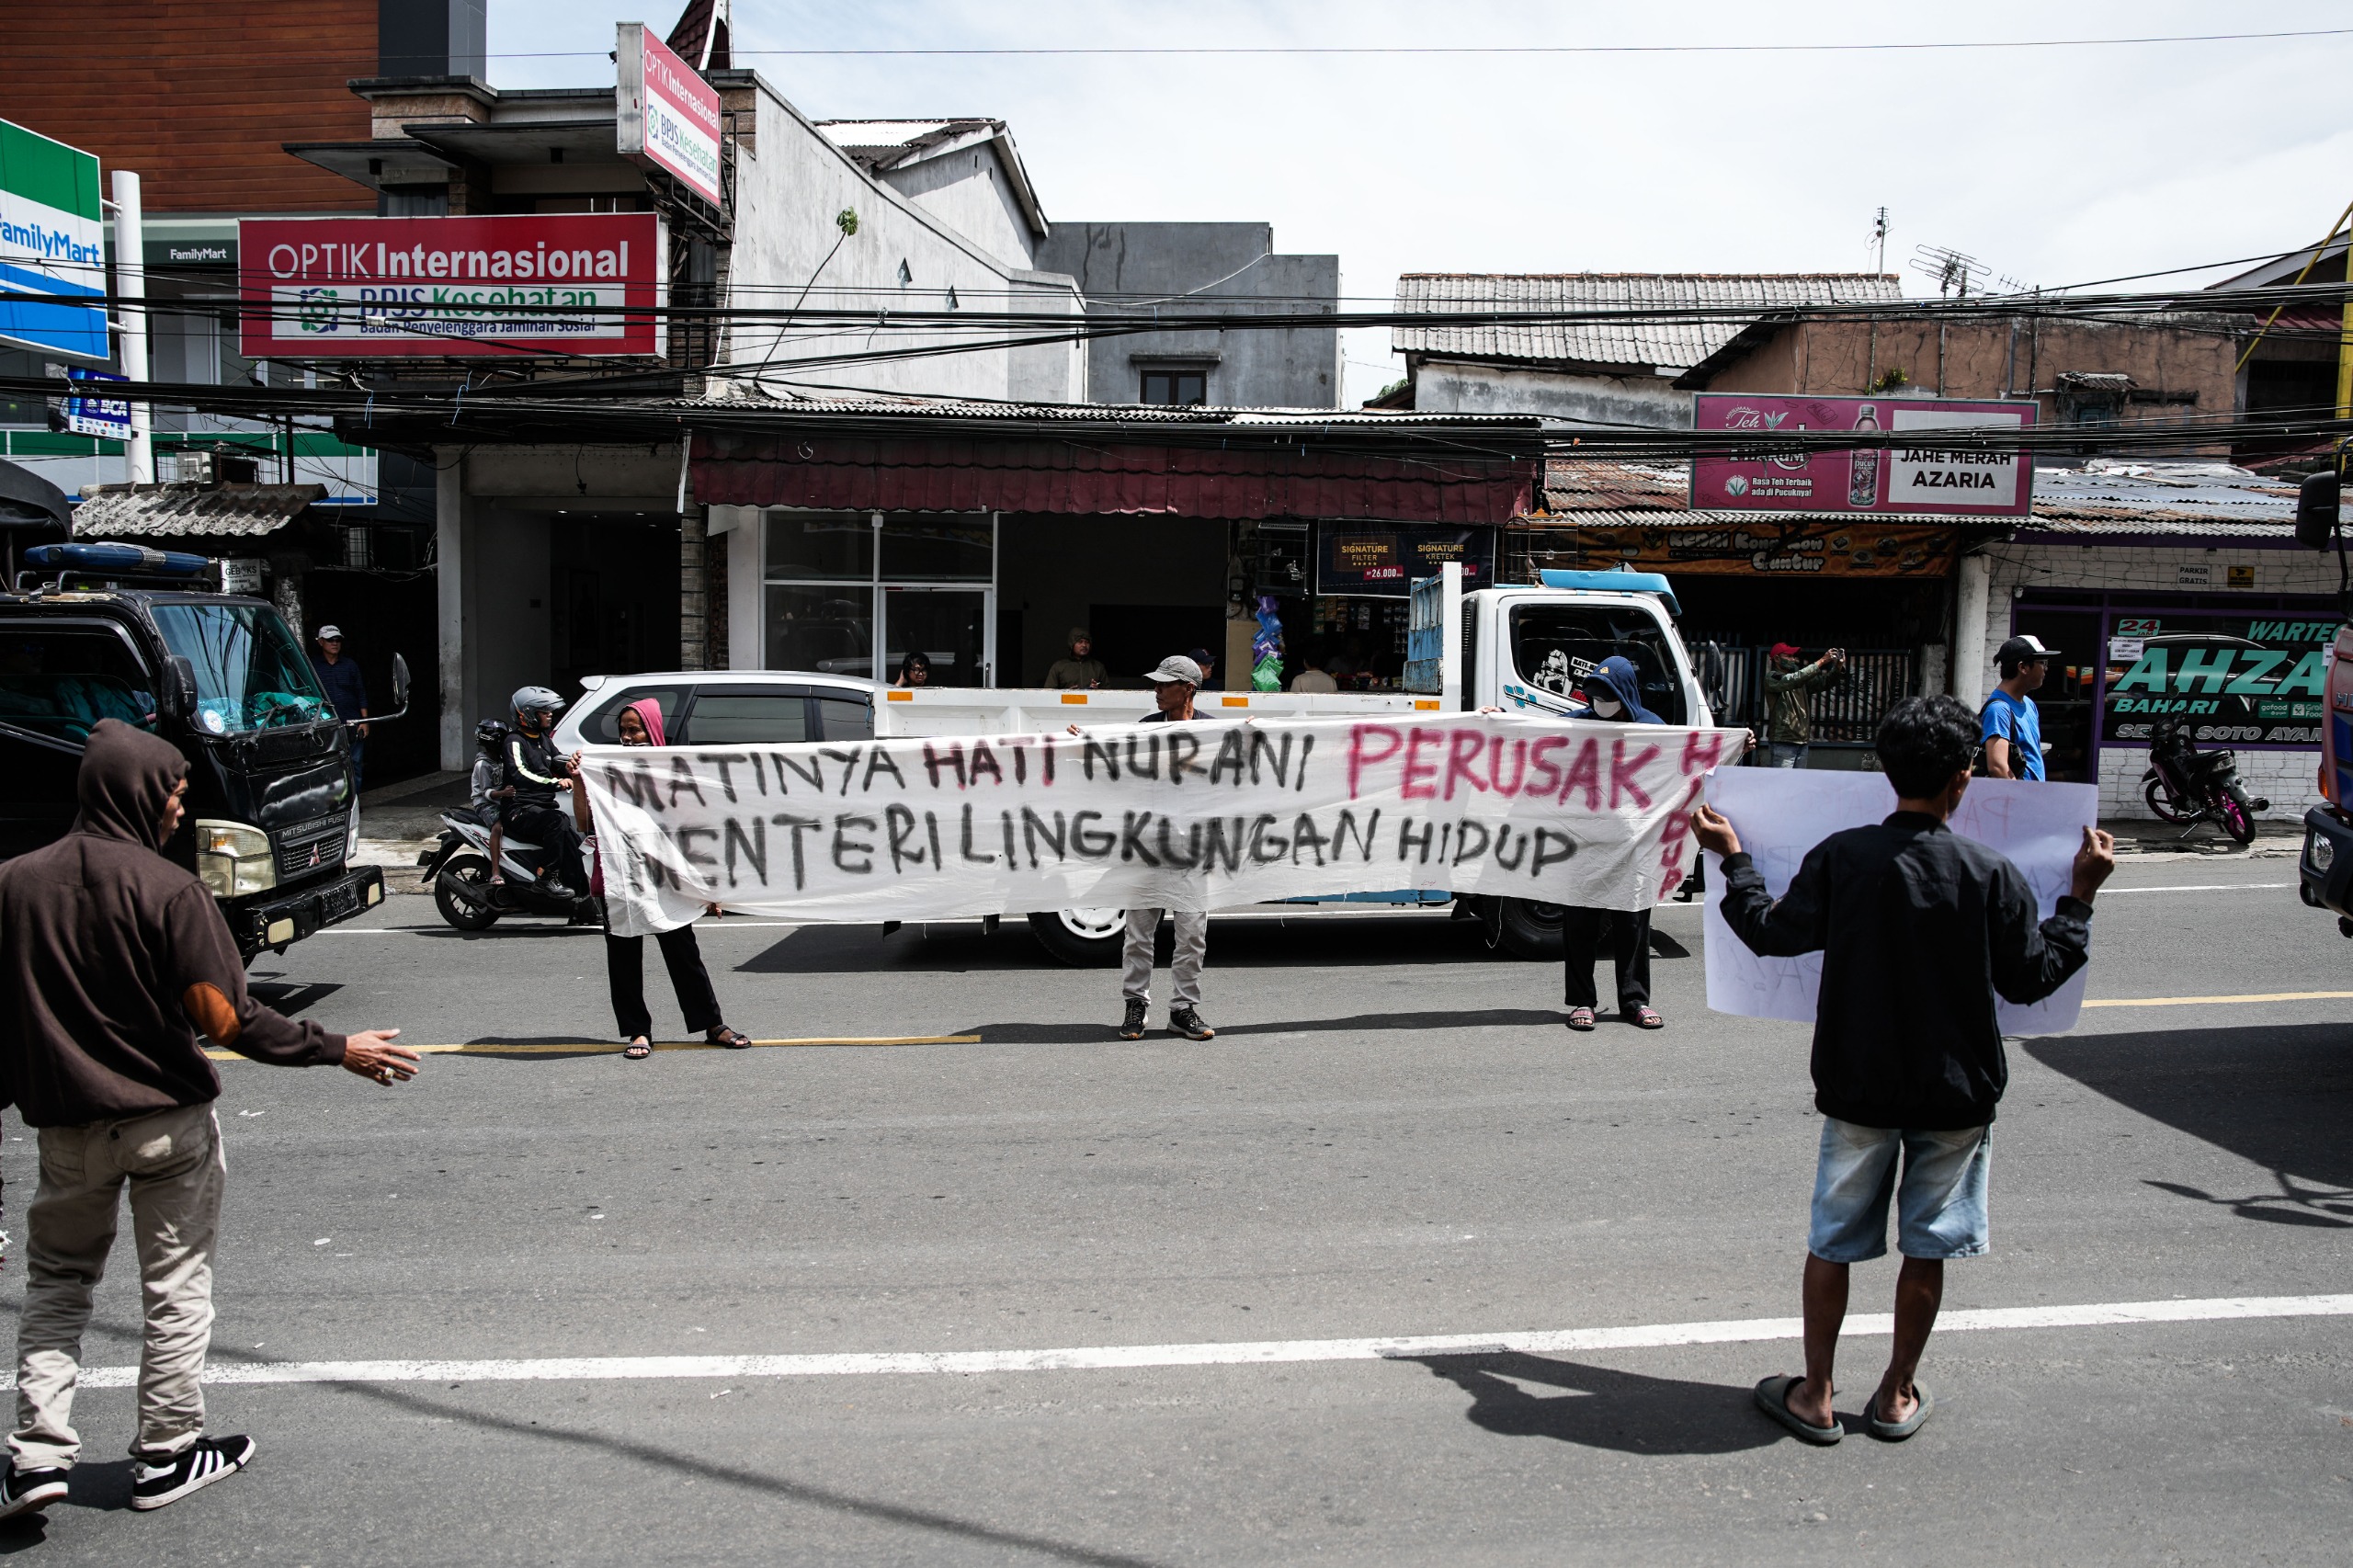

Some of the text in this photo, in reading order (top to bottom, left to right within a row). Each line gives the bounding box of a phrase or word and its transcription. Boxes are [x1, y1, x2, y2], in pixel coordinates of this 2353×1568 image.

[645, 49, 719, 131] OPTIK Internasional
[661, 114, 718, 175] BPJS Kesehatan
[0, 213, 100, 267] amilyMart
[170, 247, 227, 261] FamilyMart
[268, 241, 628, 279] OPTIK Internasional
[433, 287, 597, 318] Kesehatan
[404, 319, 496, 336] Penyelenggara
[500, 319, 553, 333] Jaminan
[100, 399, 128, 416] BCA
[1725, 410, 1760, 429] Teh
[1900, 449, 2011, 466] JAHE MERAH
[1752, 477, 1770, 486] Rasa
[1771, 478, 1784, 486] Teh
[1786, 478, 1813, 487] Terbaik
[1912, 471, 1995, 489] AZARIA
[1751, 488, 1812, 497] ada di Pucuknya!
[1341, 545, 1389, 553] SIGNATURE
[1417, 544, 1464, 552] SIGNATURE
[1371, 568, 1397, 578] 26.000
[2179, 566, 2209, 574] PARKIR
[2179, 577, 2208, 585] GRATIS
[2120, 620, 2158, 632] 24
[2114, 647, 2327, 696] AHZA
[2113, 699, 2220, 714] BAHARI
[2261, 703, 2288, 712] gofood
[2115, 723, 2191, 739] SEA
[2195, 725, 2263, 741] SOTO
[604, 743, 906, 812] MATINYA
[922, 733, 1056, 790] HATI
[1083, 729, 1315, 791] NURANI
[1347, 722, 1663, 812] PERUSAK
[281, 814, 346, 838] MITSUBISHI FUSO
[961, 801, 1382, 872] LINGKUNGAN
[1398, 816, 1577, 877] HIDUP
